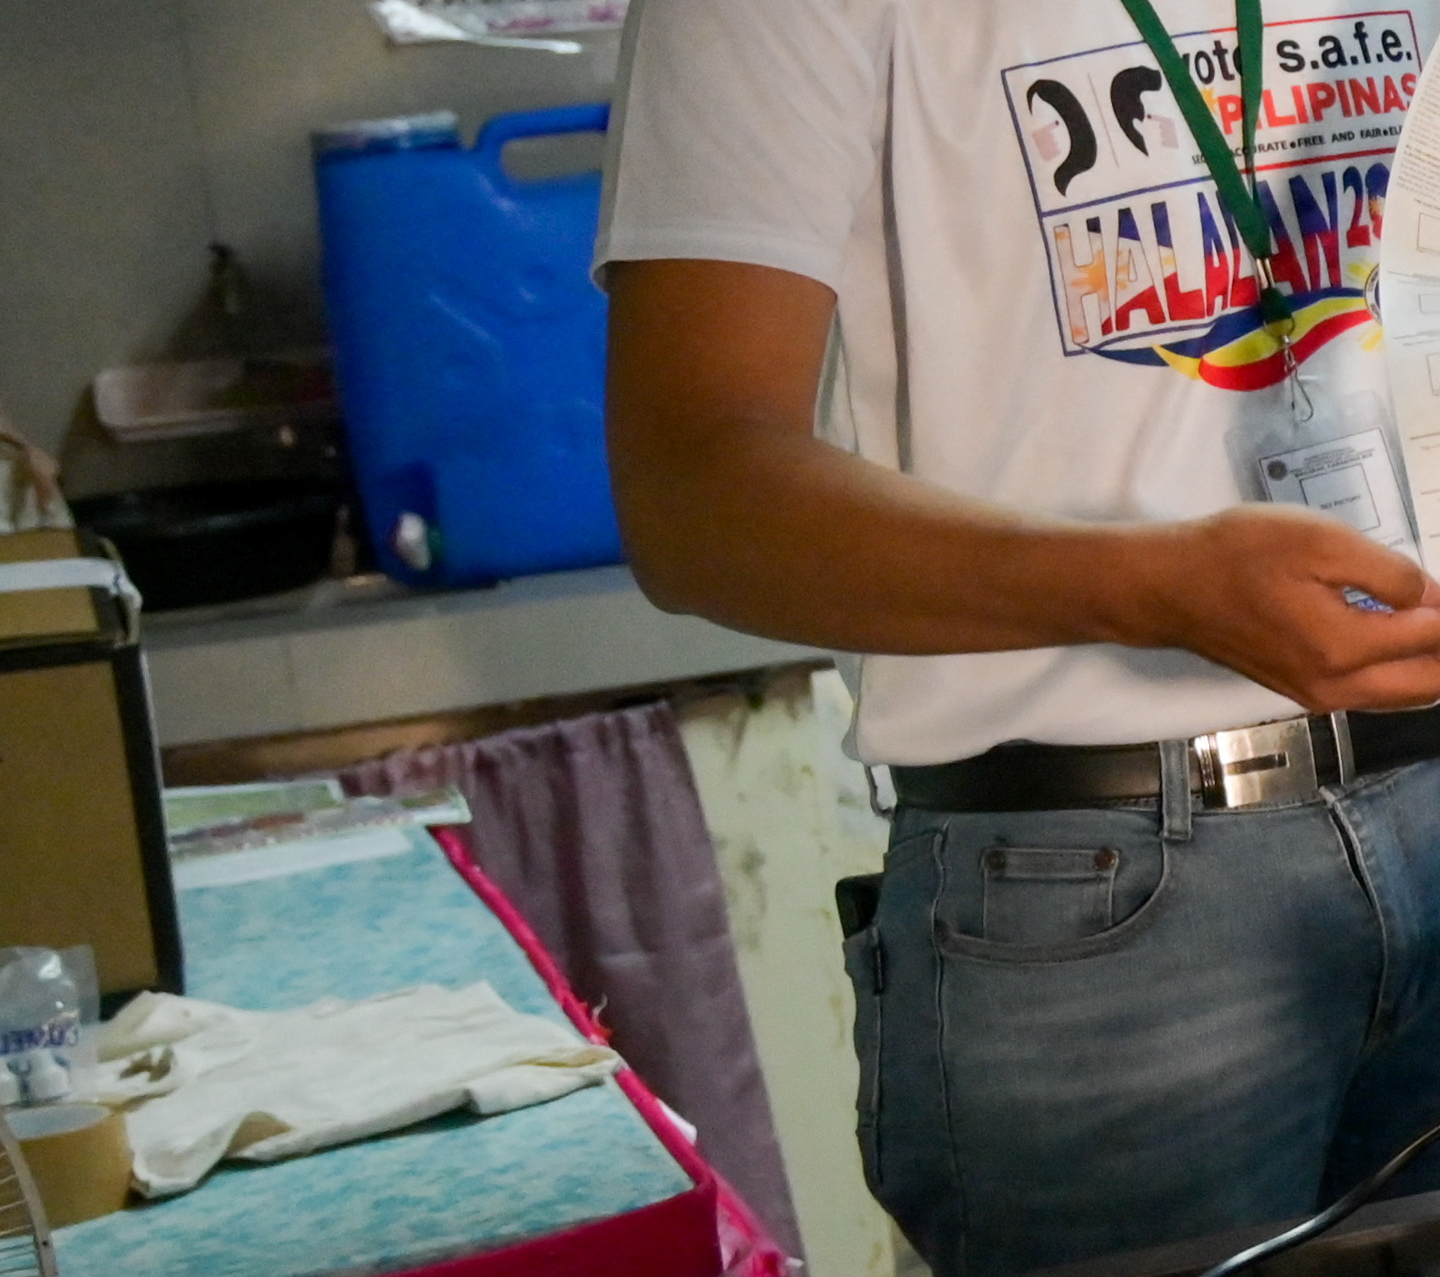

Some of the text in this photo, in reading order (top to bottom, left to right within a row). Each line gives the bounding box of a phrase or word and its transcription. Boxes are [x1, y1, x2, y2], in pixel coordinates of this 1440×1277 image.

[1276, 21, 1413, 73] s.a.f.e.
[1217, 73, 1417, 135] PLIPINAS
[1331, 130, 1356, 143] AND
[1360, 127, 1383, 140] FAIR
